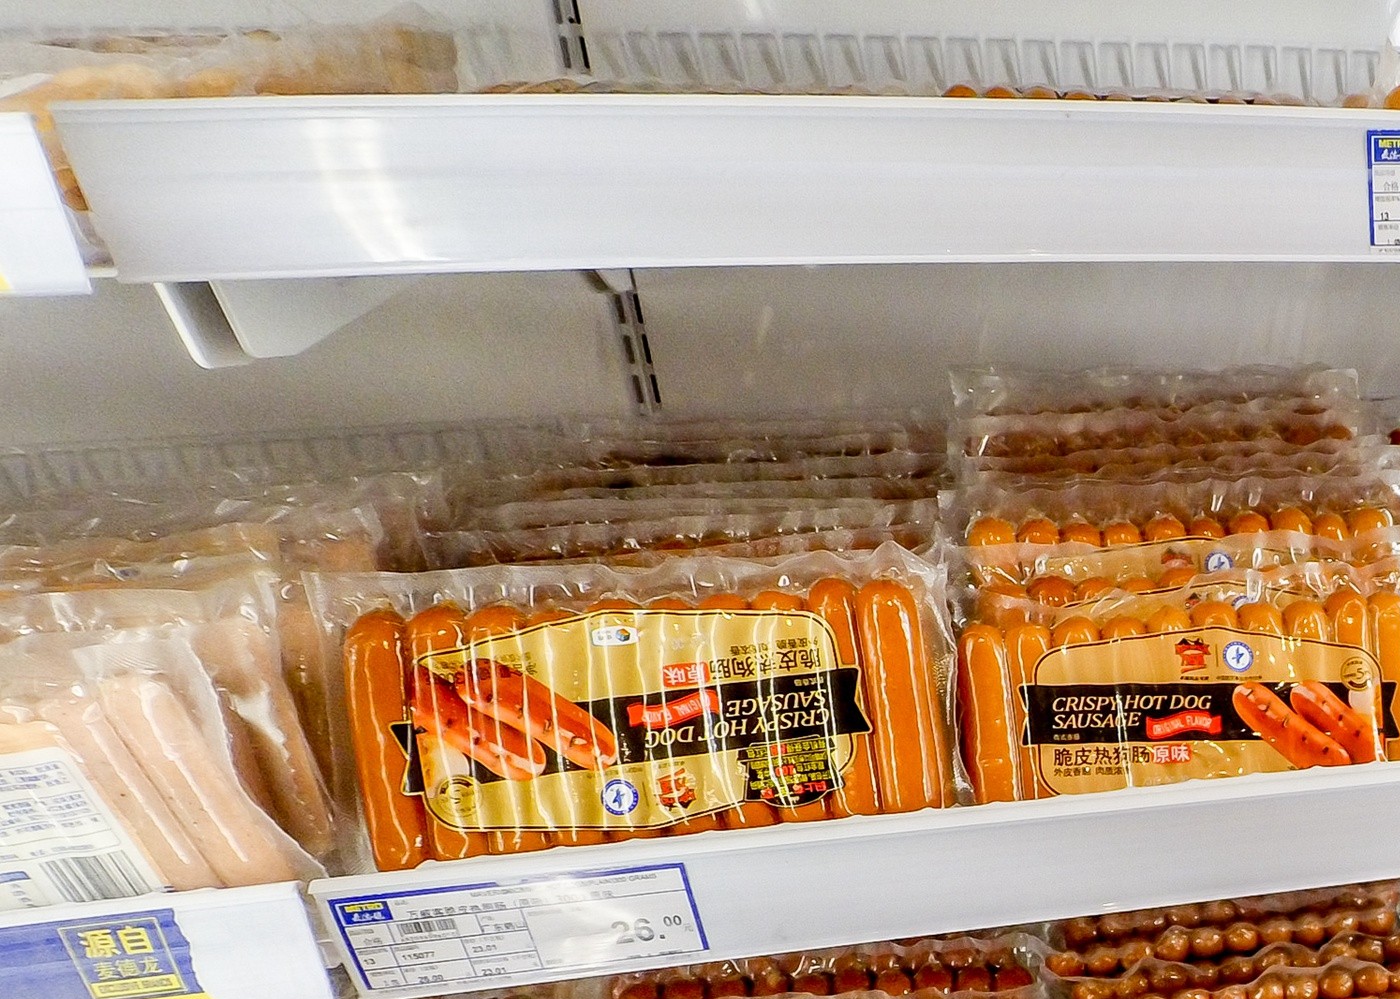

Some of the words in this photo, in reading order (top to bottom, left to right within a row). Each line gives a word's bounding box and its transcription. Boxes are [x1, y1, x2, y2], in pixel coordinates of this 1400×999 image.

[1380, 212, 1389, 220] 13
[662, 663, 706, 685] 原味
[725, 688, 827, 718] SAUSAGE
[1052, 696, 1120, 712] CRISPY
[1125, 695, 1168, 711] HOT
[1169, 695, 1212, 710] DOG
[697, 719, 748, 741] HOT
[750, 707, 830, 736] CRISPY
[1052, 712, 1142, 730] SAUSAGE
[1186, 715, 1213, 728] FLAVOR
[644, 725, 694, 748] DOG
[1053, 745, 1150, 767] 脆皮热狗肠
[1153, 745, 1191, 763] 原味
[611, 915, 682, 944] 26.00
[78, 926, 155, 958] 源自
[93, 957, 163, 979] 麦德龙
